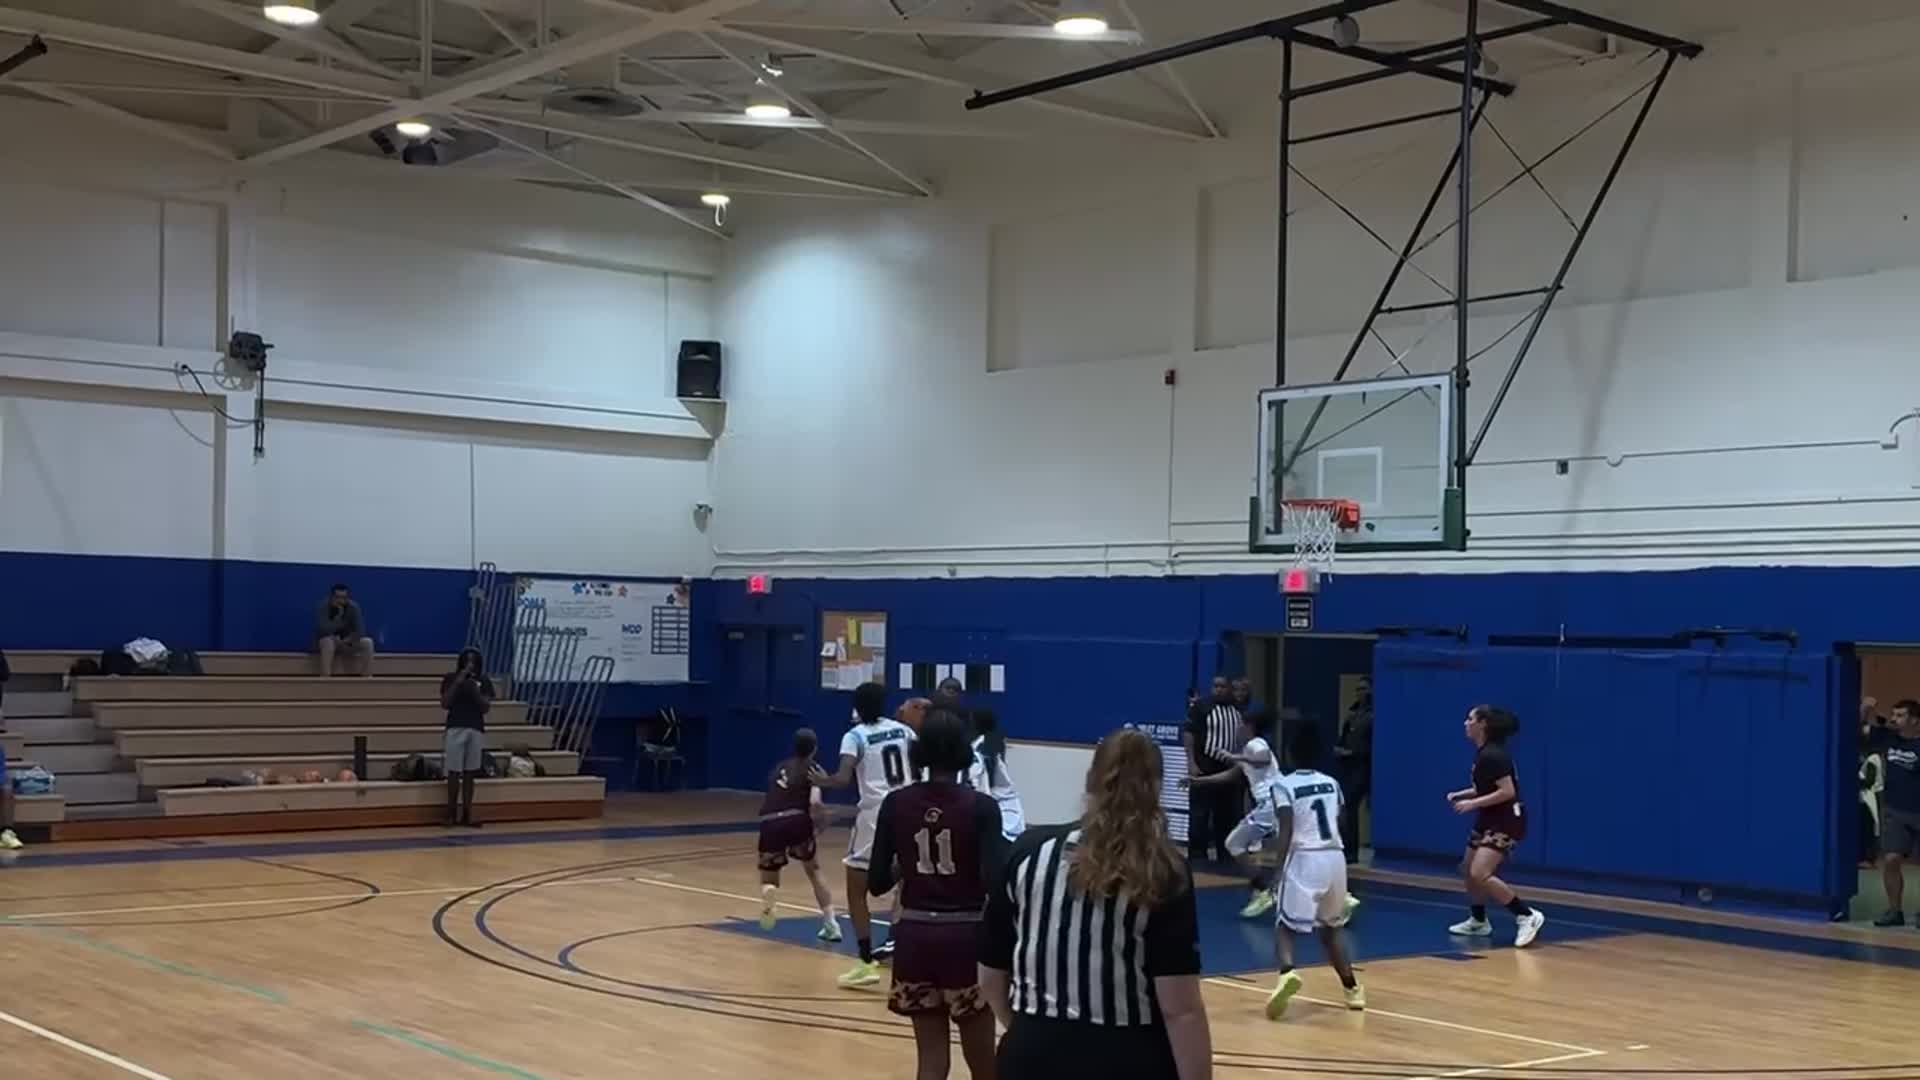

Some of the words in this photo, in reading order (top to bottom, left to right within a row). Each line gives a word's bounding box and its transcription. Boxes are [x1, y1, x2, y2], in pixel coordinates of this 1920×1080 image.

[881, 744, 905, 788] 0
[1310, 798, 1332, 840] 1
[914, 827, 956, 875] 11
